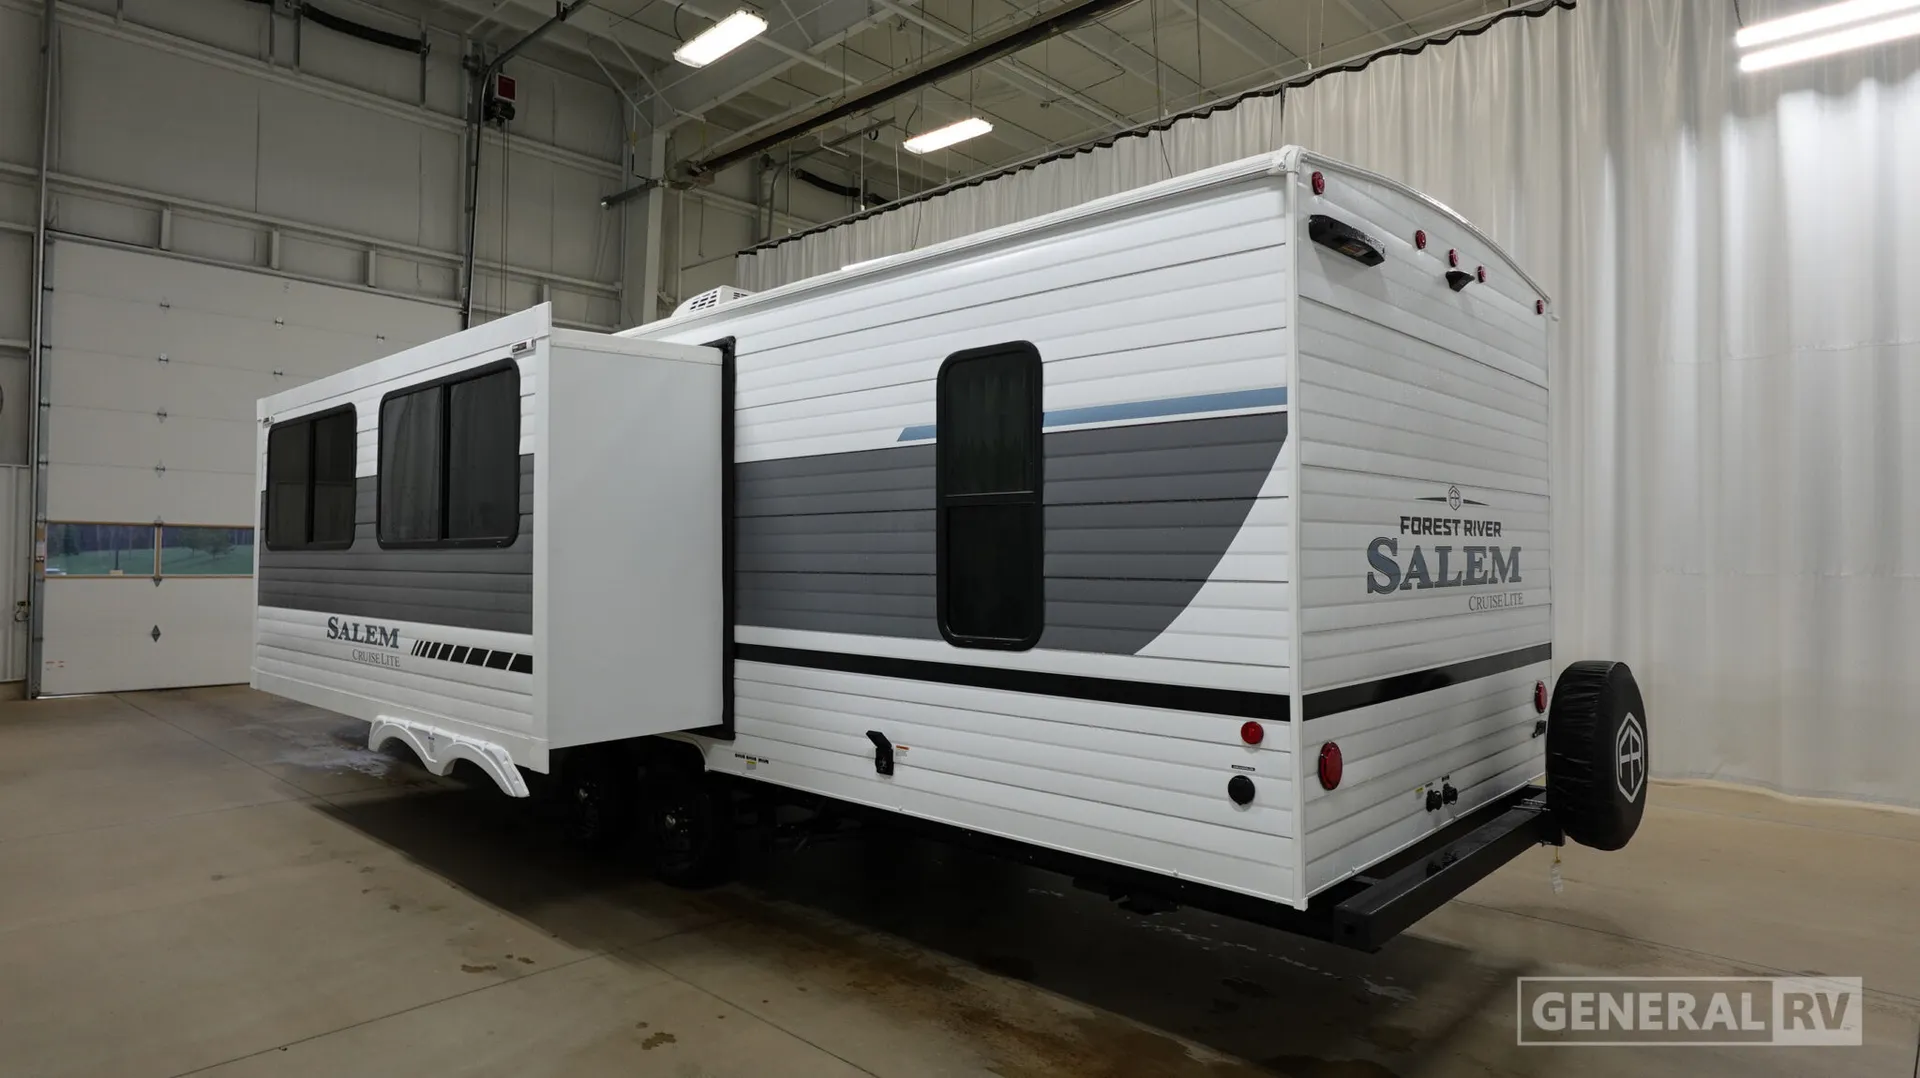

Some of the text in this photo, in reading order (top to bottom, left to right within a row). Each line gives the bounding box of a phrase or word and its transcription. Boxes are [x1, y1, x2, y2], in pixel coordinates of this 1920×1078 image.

[1400, 516, 1502, 537] FOREST RIVER
[1367, 537, 1522, 594] SALEM
[327, 616, 399, 649] SALEM
